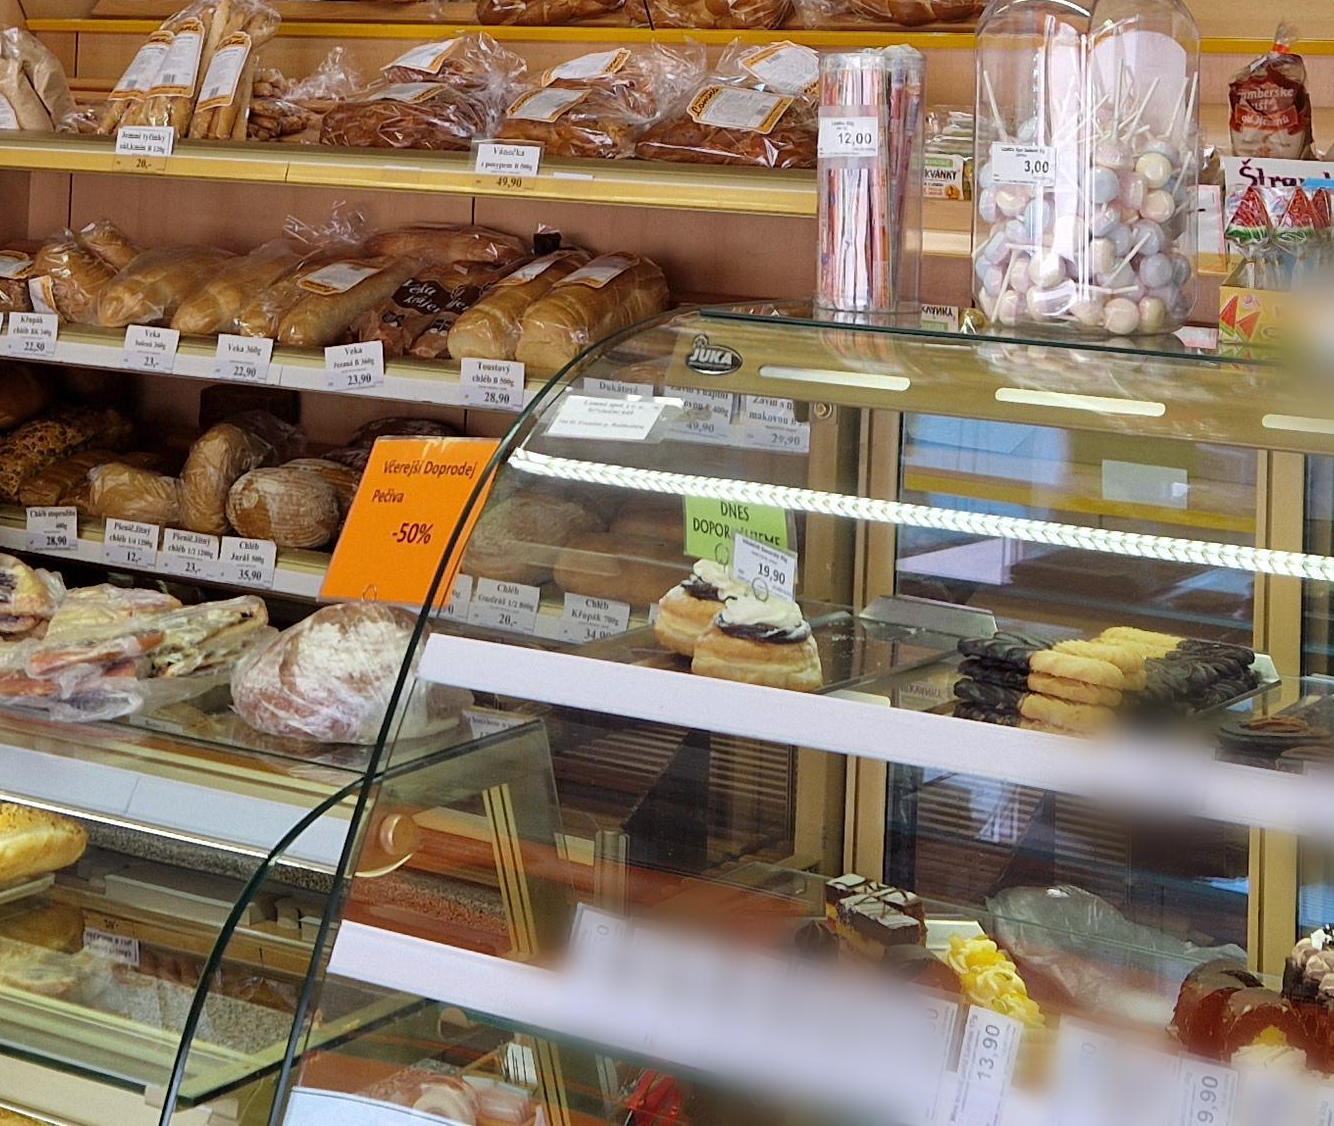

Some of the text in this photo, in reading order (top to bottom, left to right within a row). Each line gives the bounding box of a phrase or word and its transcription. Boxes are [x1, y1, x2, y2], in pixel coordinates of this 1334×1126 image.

[838, 133, 872, 145] 12,00
[1024, 160, 1049, 175] 3,00
[495, 177, 522, 188] 49,90
[145, 328, 161, 338] Veka
[227, 343, 262, 356] Veka 360g
[345, 346, 363, 356] Veka
[689, 345, 734, 366] JUKA
[143, 356, 160, 368] 23,-
[477, 361, 510, 373] Toustový
[233, 366, 257, 378] 22,90
[347, 374, 372, 386] 23,90
[472, 375, 492, 384] chléb
[484, 391, 510, 404] 28,90
[384, 460, 478, 480] Včerejší Doprodej
[372, 489, 405, 503] Pečiva
[30, 509, 47, 518] Chléb
[720, 501, 750, 522] DNES
[109, 534, 126, 543] chléb
[392, 523, 434, 545] -50%
[45, 536, 67, 547] 28,90
[239, 540, 259, 551] Chléb
[168, 544, 185, 554] chléb
[126, 551, 142, 562] 12,-
[185, 561, 201, 573] 23,-
[238, 569, 262, 581] 35,90
[758, 563, 786, 585] 19,90
[497, 583, 520, 596] Chléb
[585, 598, 609, 611] Chléb
[499, 613, 518, 627] 20,-
[571, 609, 601, 622] Křupák
[977, 1024, 1000, 1080] 13,90
